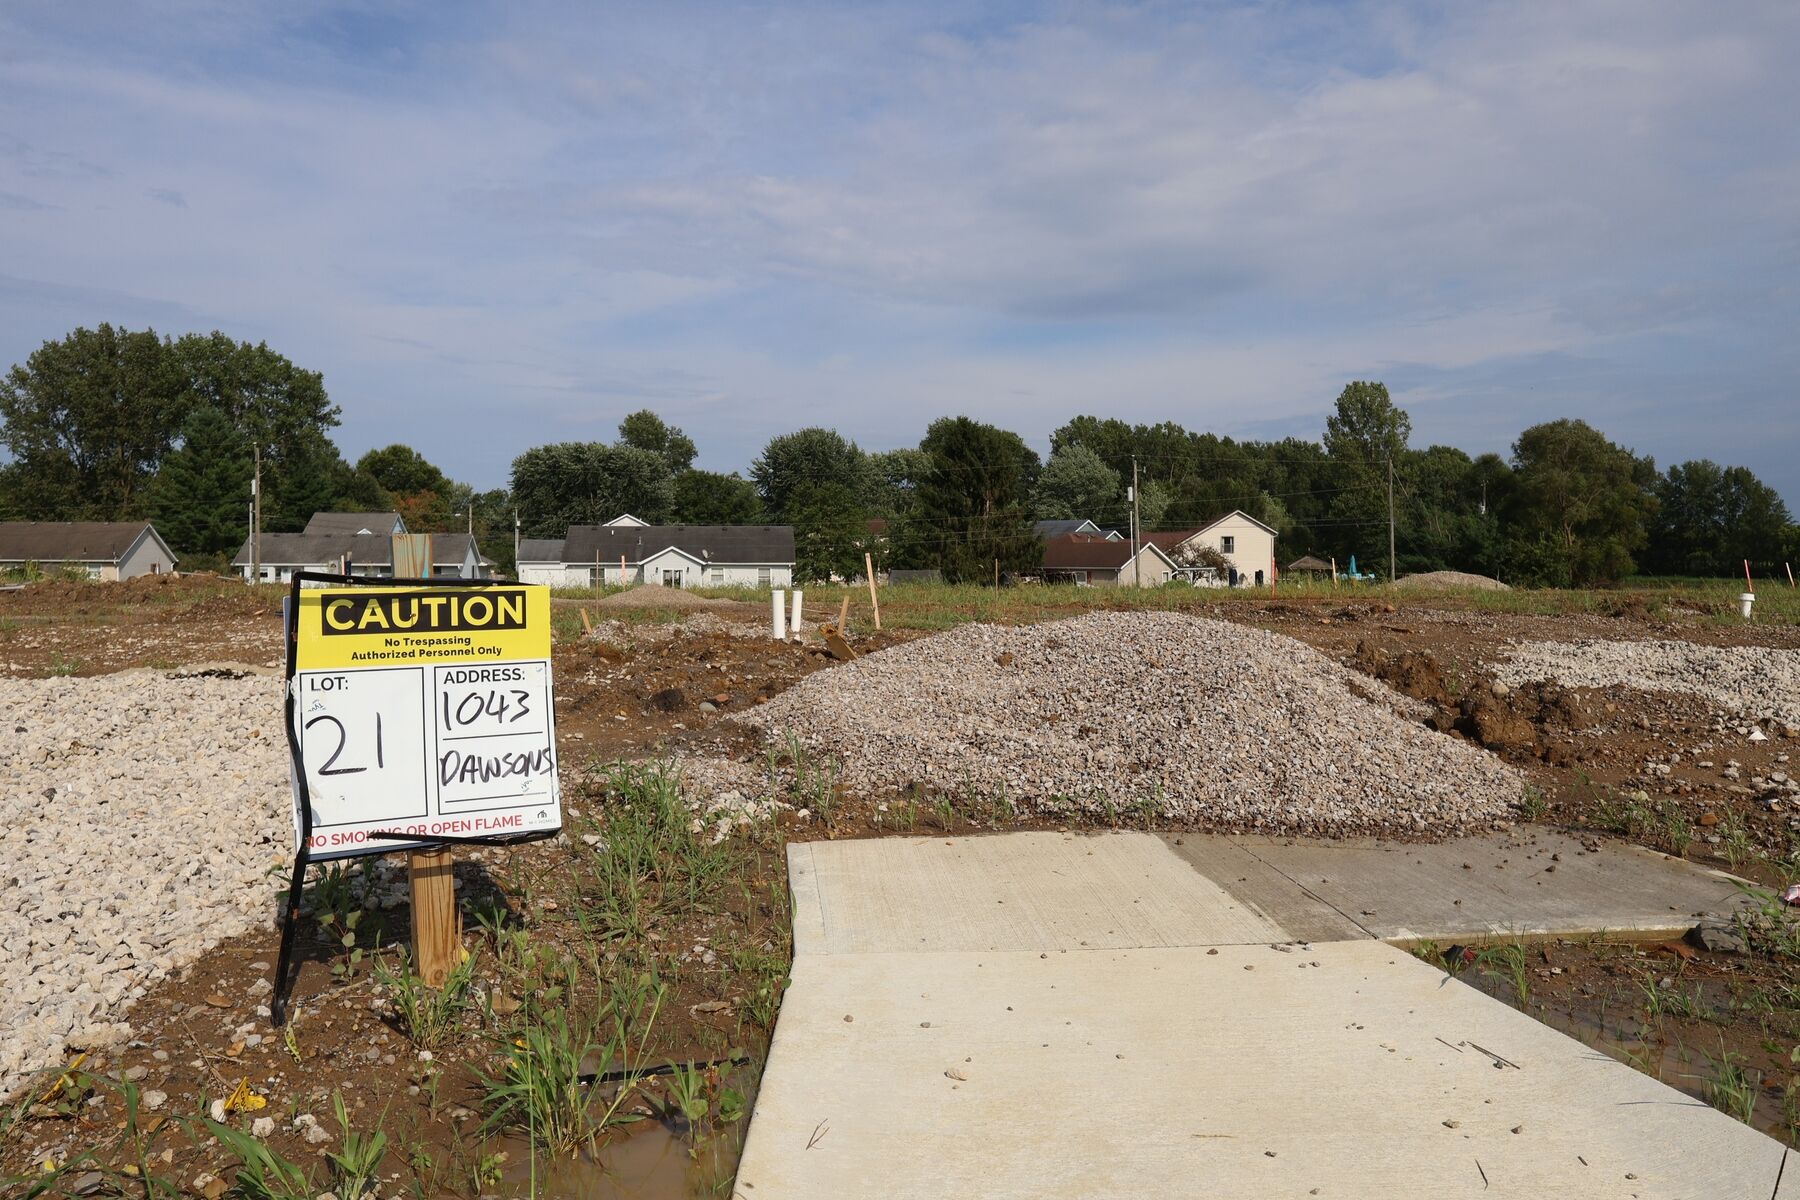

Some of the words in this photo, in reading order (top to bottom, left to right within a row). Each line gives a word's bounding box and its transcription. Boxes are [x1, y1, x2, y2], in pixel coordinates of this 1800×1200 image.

[325, 595, 523, 631] CAUTION
[384, 637, 400, 647] No
[402, 636, 472, 647] Trespassing
[351, 649, 416, 661] Authorized
[418, 647, 475, 658] Personnel
[477, 646, 502, 656] Only
[310, 676, 349, 692] LOT:
[443, 668, 526, 685] ADDRESS:
[442, 690, 530, 731] 1043
[305, 712, 384, 776] 21
[439, 746, 555, 786] DAWSONS
[406, 824, 427, 837] OR
[431, 819, 471, 835] OPEN
[475, 814, 523, 830] FLAME
